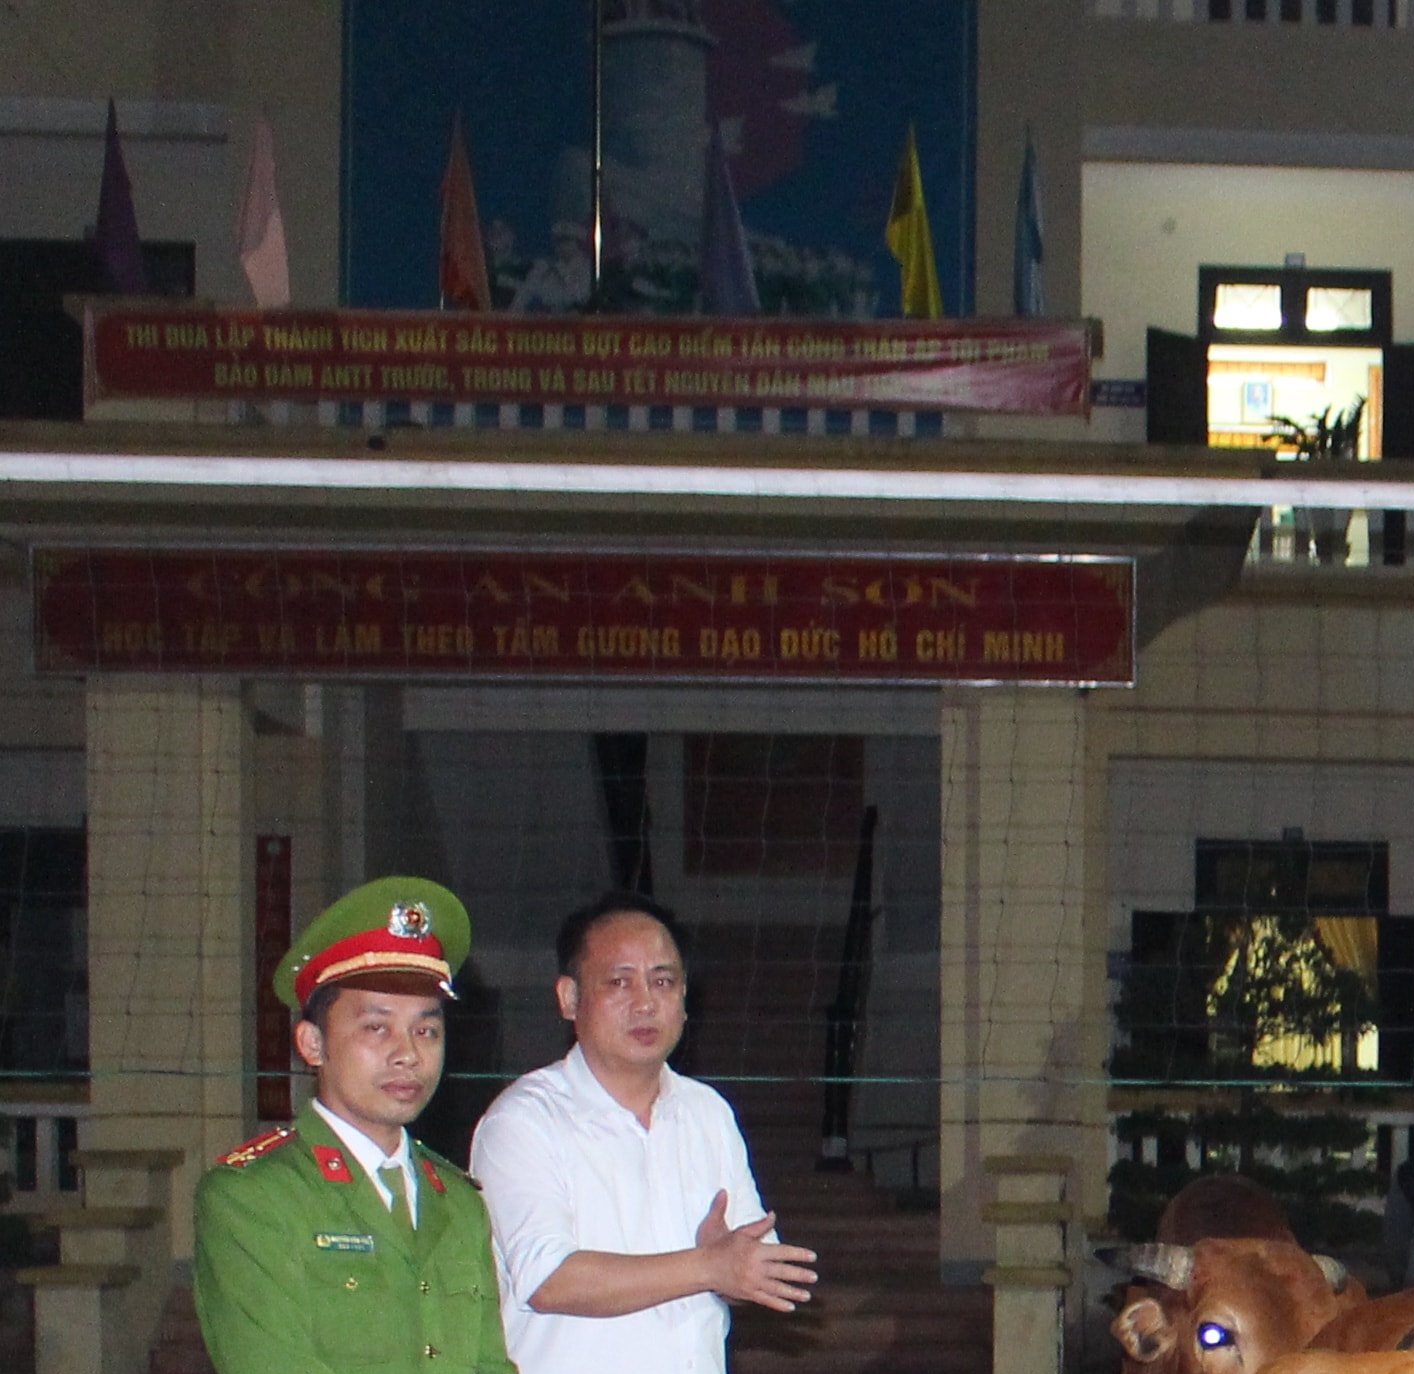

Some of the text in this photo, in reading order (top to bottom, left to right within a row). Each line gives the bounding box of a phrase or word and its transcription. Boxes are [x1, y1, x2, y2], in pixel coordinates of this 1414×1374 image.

[127, 324, 159, 350] THI
[507, 331, 577, 355] TRONG
[629, 333, 671, 356] CAO
[464, 366, 532, 392] TRONG
[573, 369, 616, 395] SAU
[400, 623, 475, 656] THEO
[983, 630, 1065, 664] MINH
